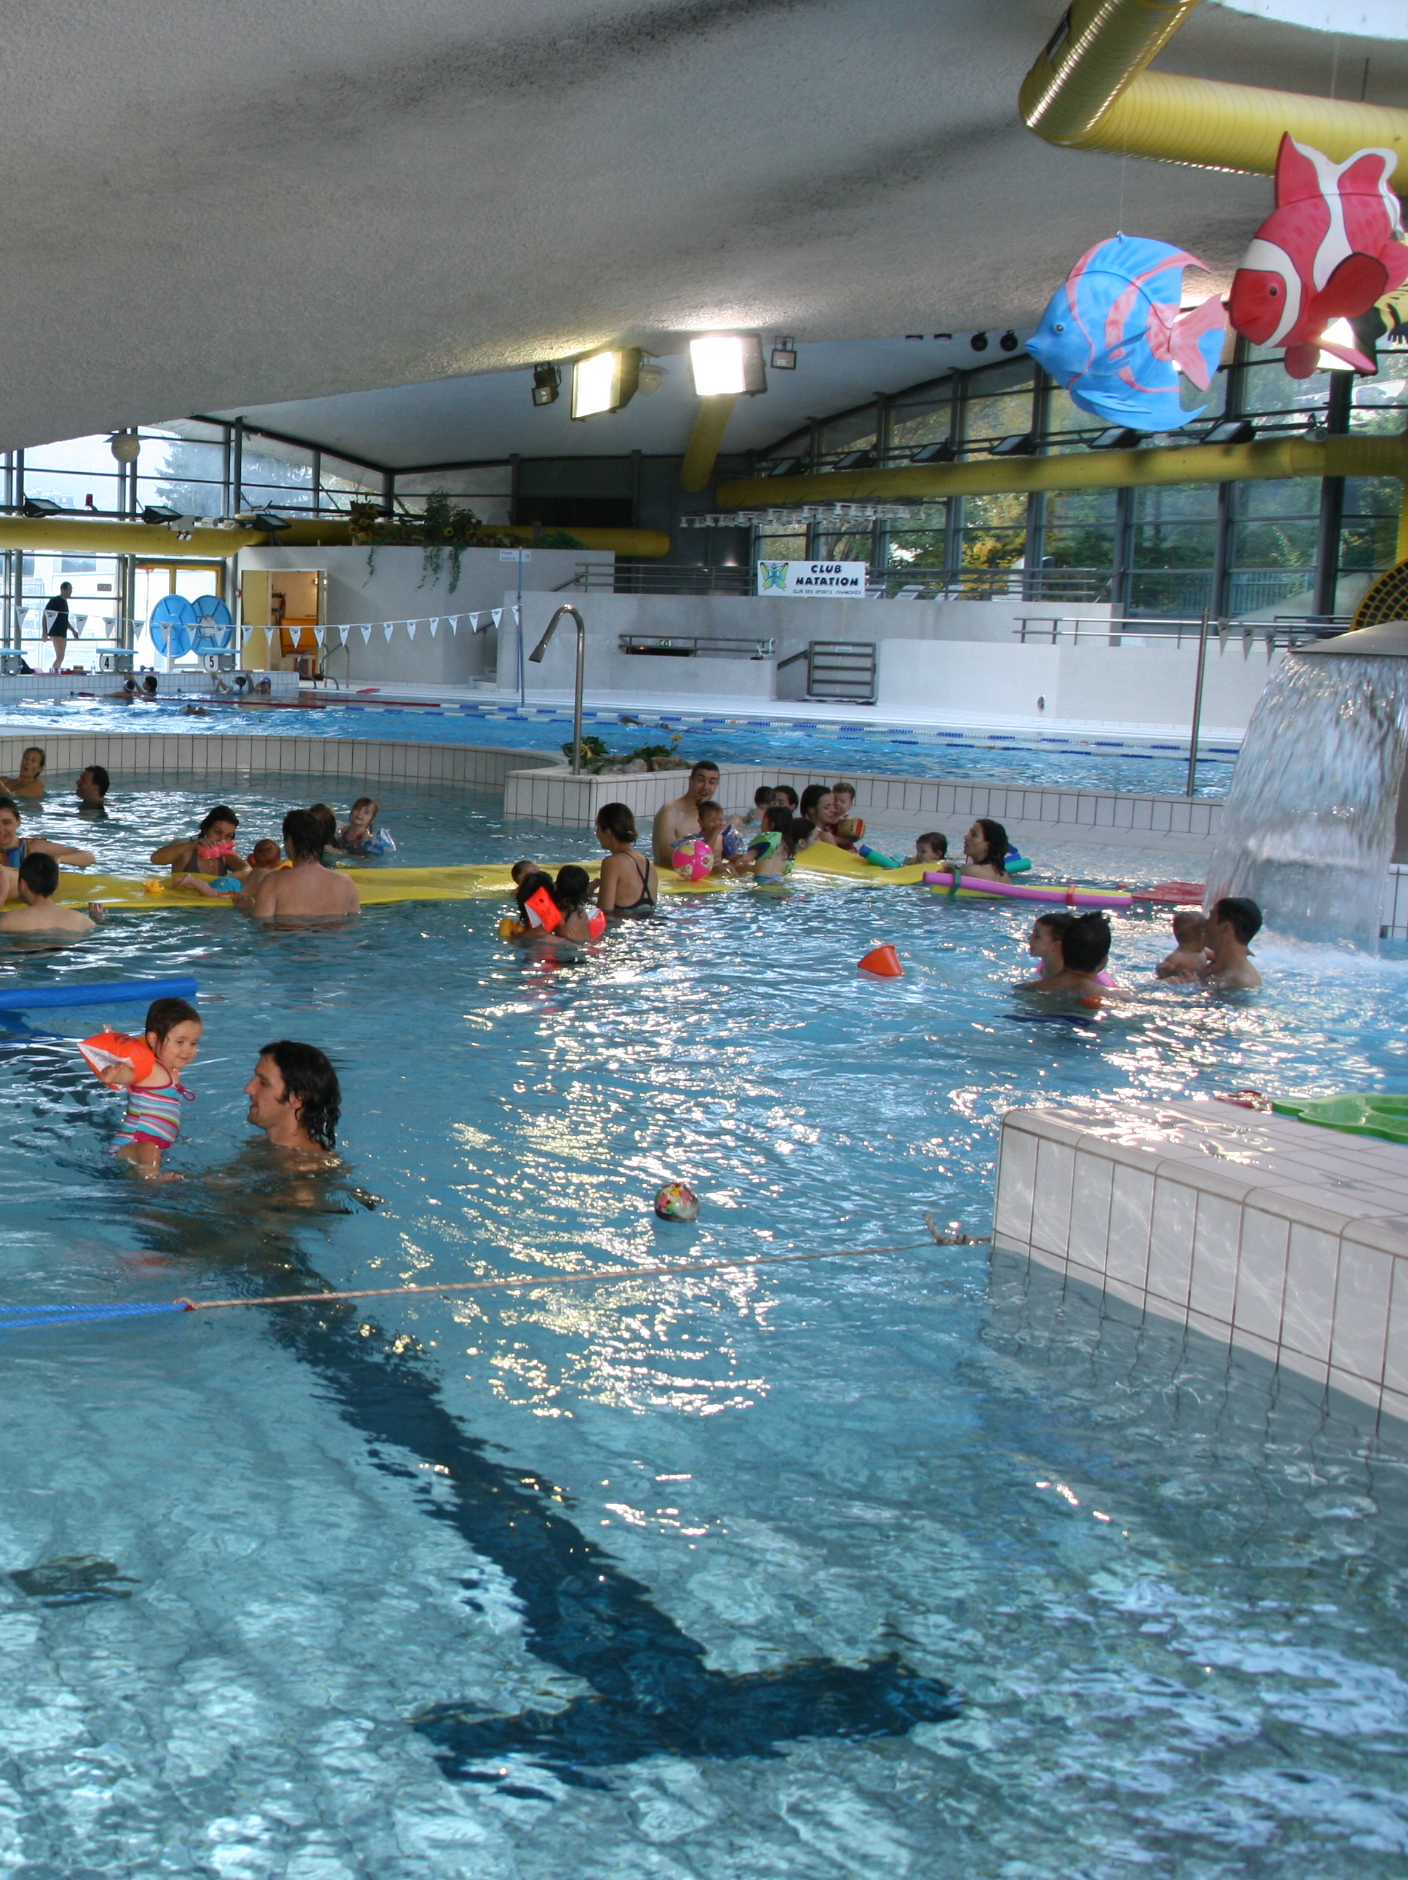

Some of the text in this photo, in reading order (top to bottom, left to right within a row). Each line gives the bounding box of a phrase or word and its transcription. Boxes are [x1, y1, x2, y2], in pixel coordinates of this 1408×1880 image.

[810, 564, 842, 574] CLUB
[795, 577, 859, 586] NATATION
[104, 657, 110, 670] 4
[209, 655, 215, 668] 5
